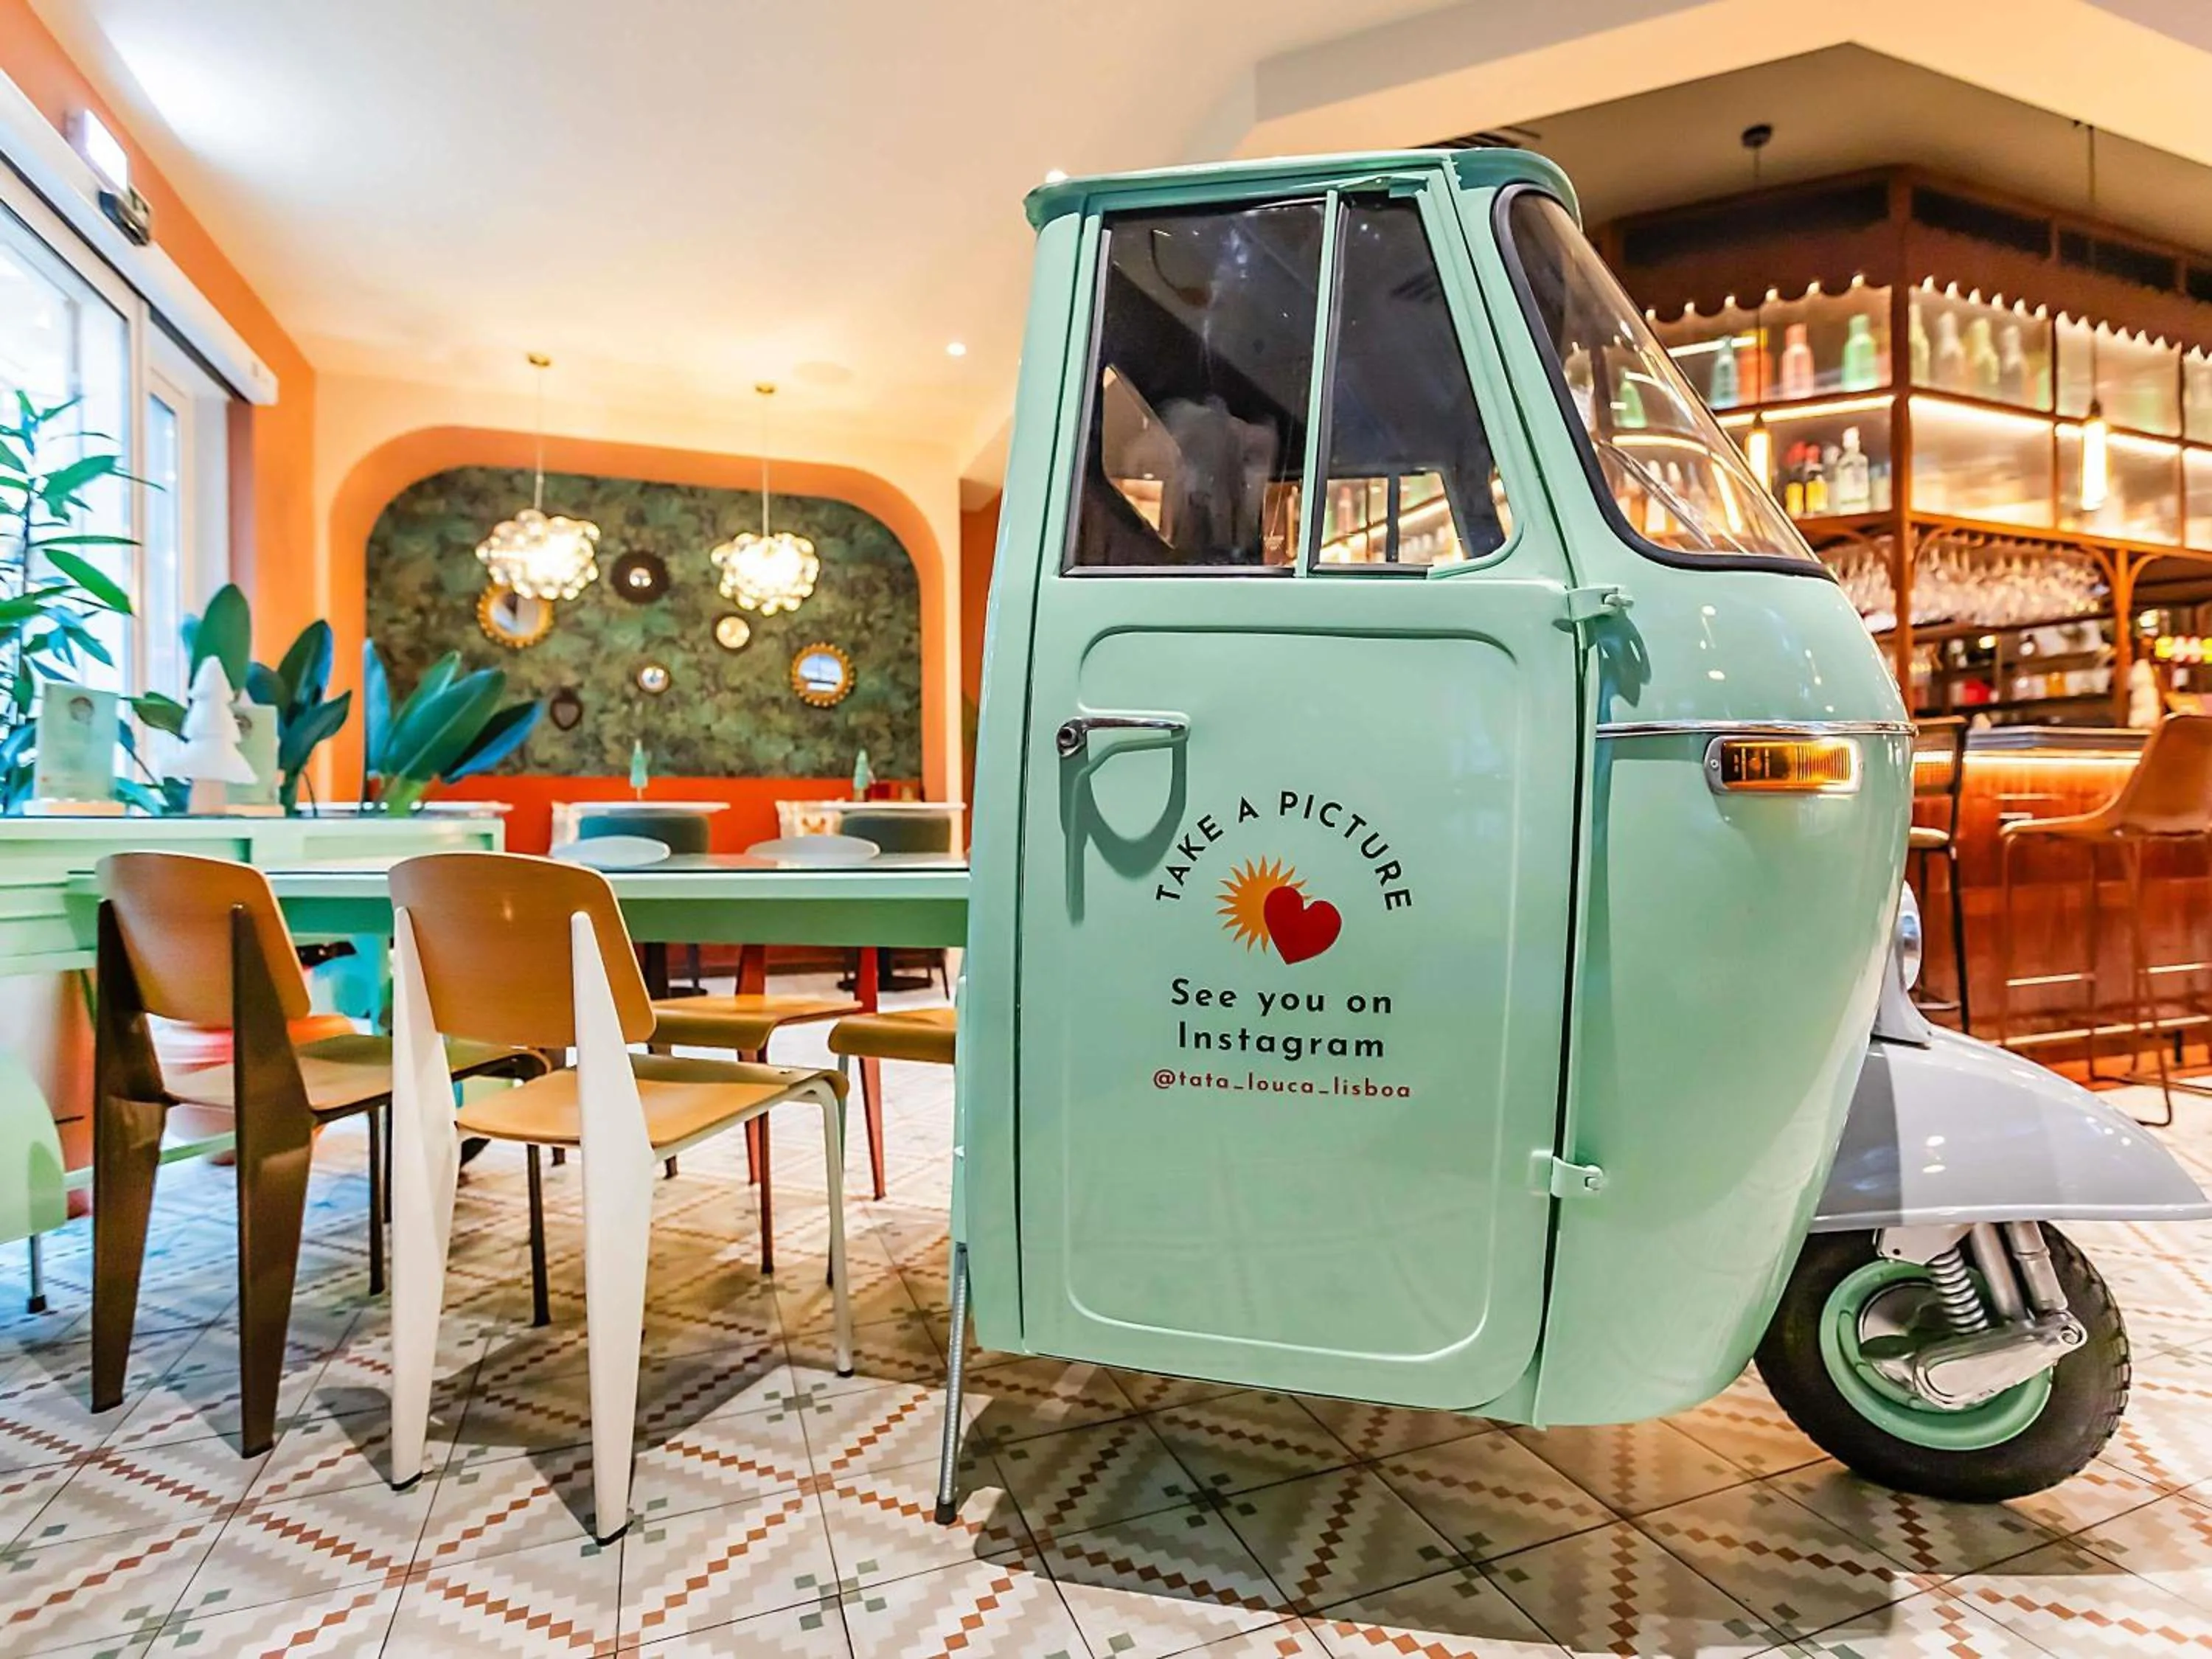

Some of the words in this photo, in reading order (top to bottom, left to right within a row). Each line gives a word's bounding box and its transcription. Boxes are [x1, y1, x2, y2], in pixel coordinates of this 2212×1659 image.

[1155, 814, 1224, 901] TAKE
[1238, 796, 1259, 823] A
[1279, 790, 1412, 911] PICTURE
[1171, 978, 1237, 1008] See
[1257, 992, 1324, 1016] you
[1347, 994, 1391, 1014] on
[1179, 1021, 1384, 1061] Instagram
[1153, 1068, 1411, 1097] @tata_louca_lisboa
